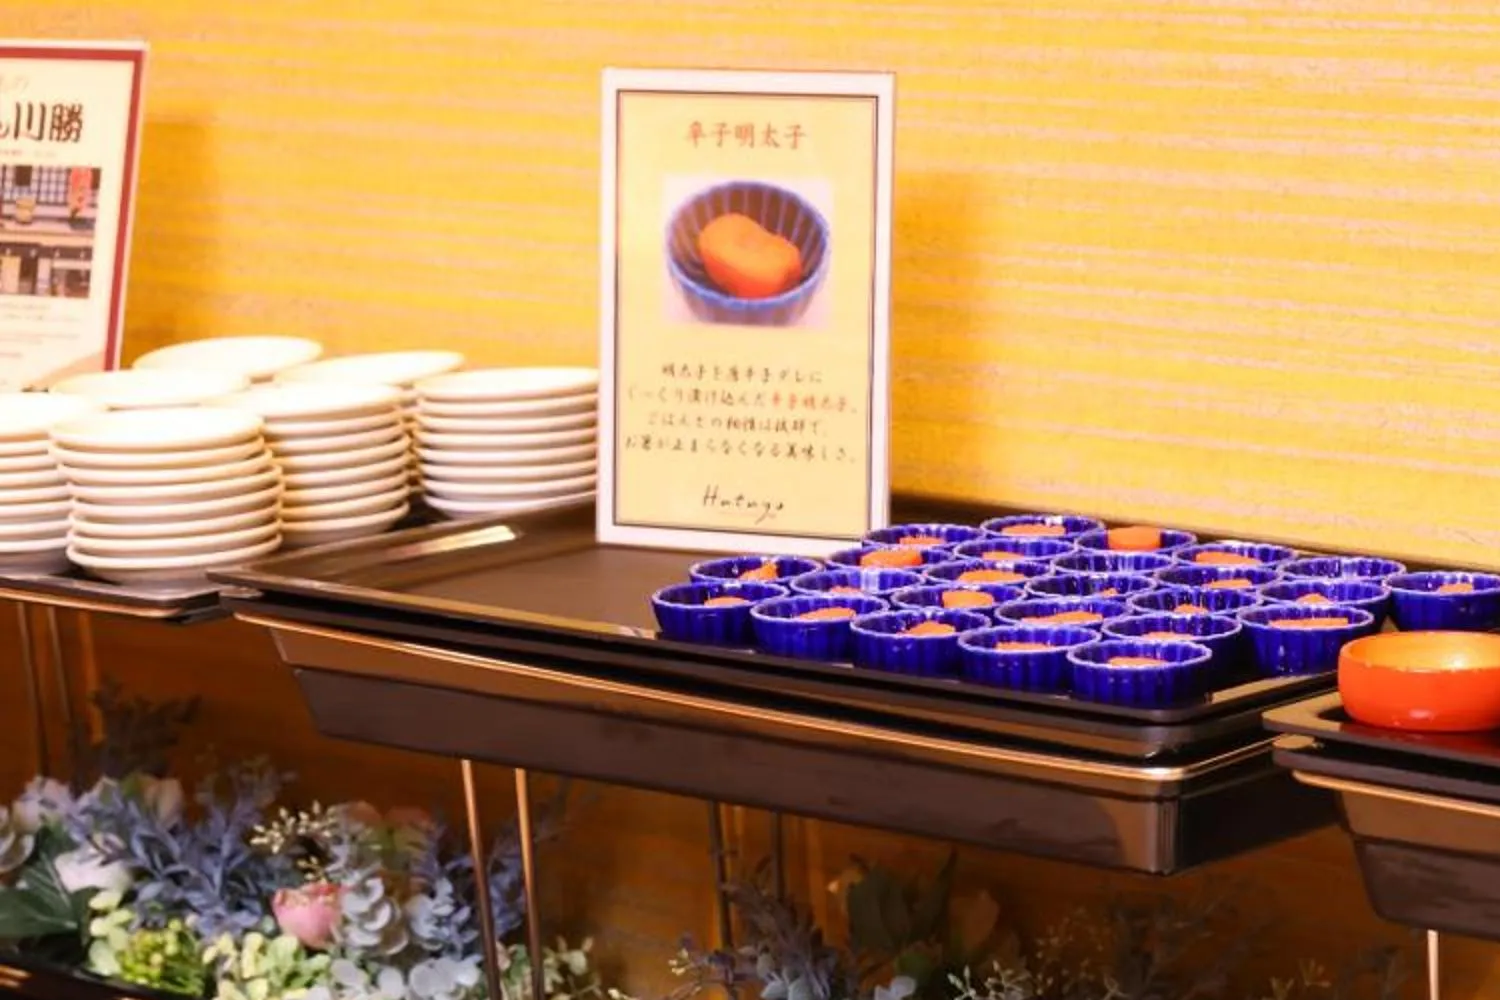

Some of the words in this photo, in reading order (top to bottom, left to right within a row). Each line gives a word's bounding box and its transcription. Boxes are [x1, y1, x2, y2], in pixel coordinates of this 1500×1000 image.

[684, 120, 808, 150] 辛子明太子
